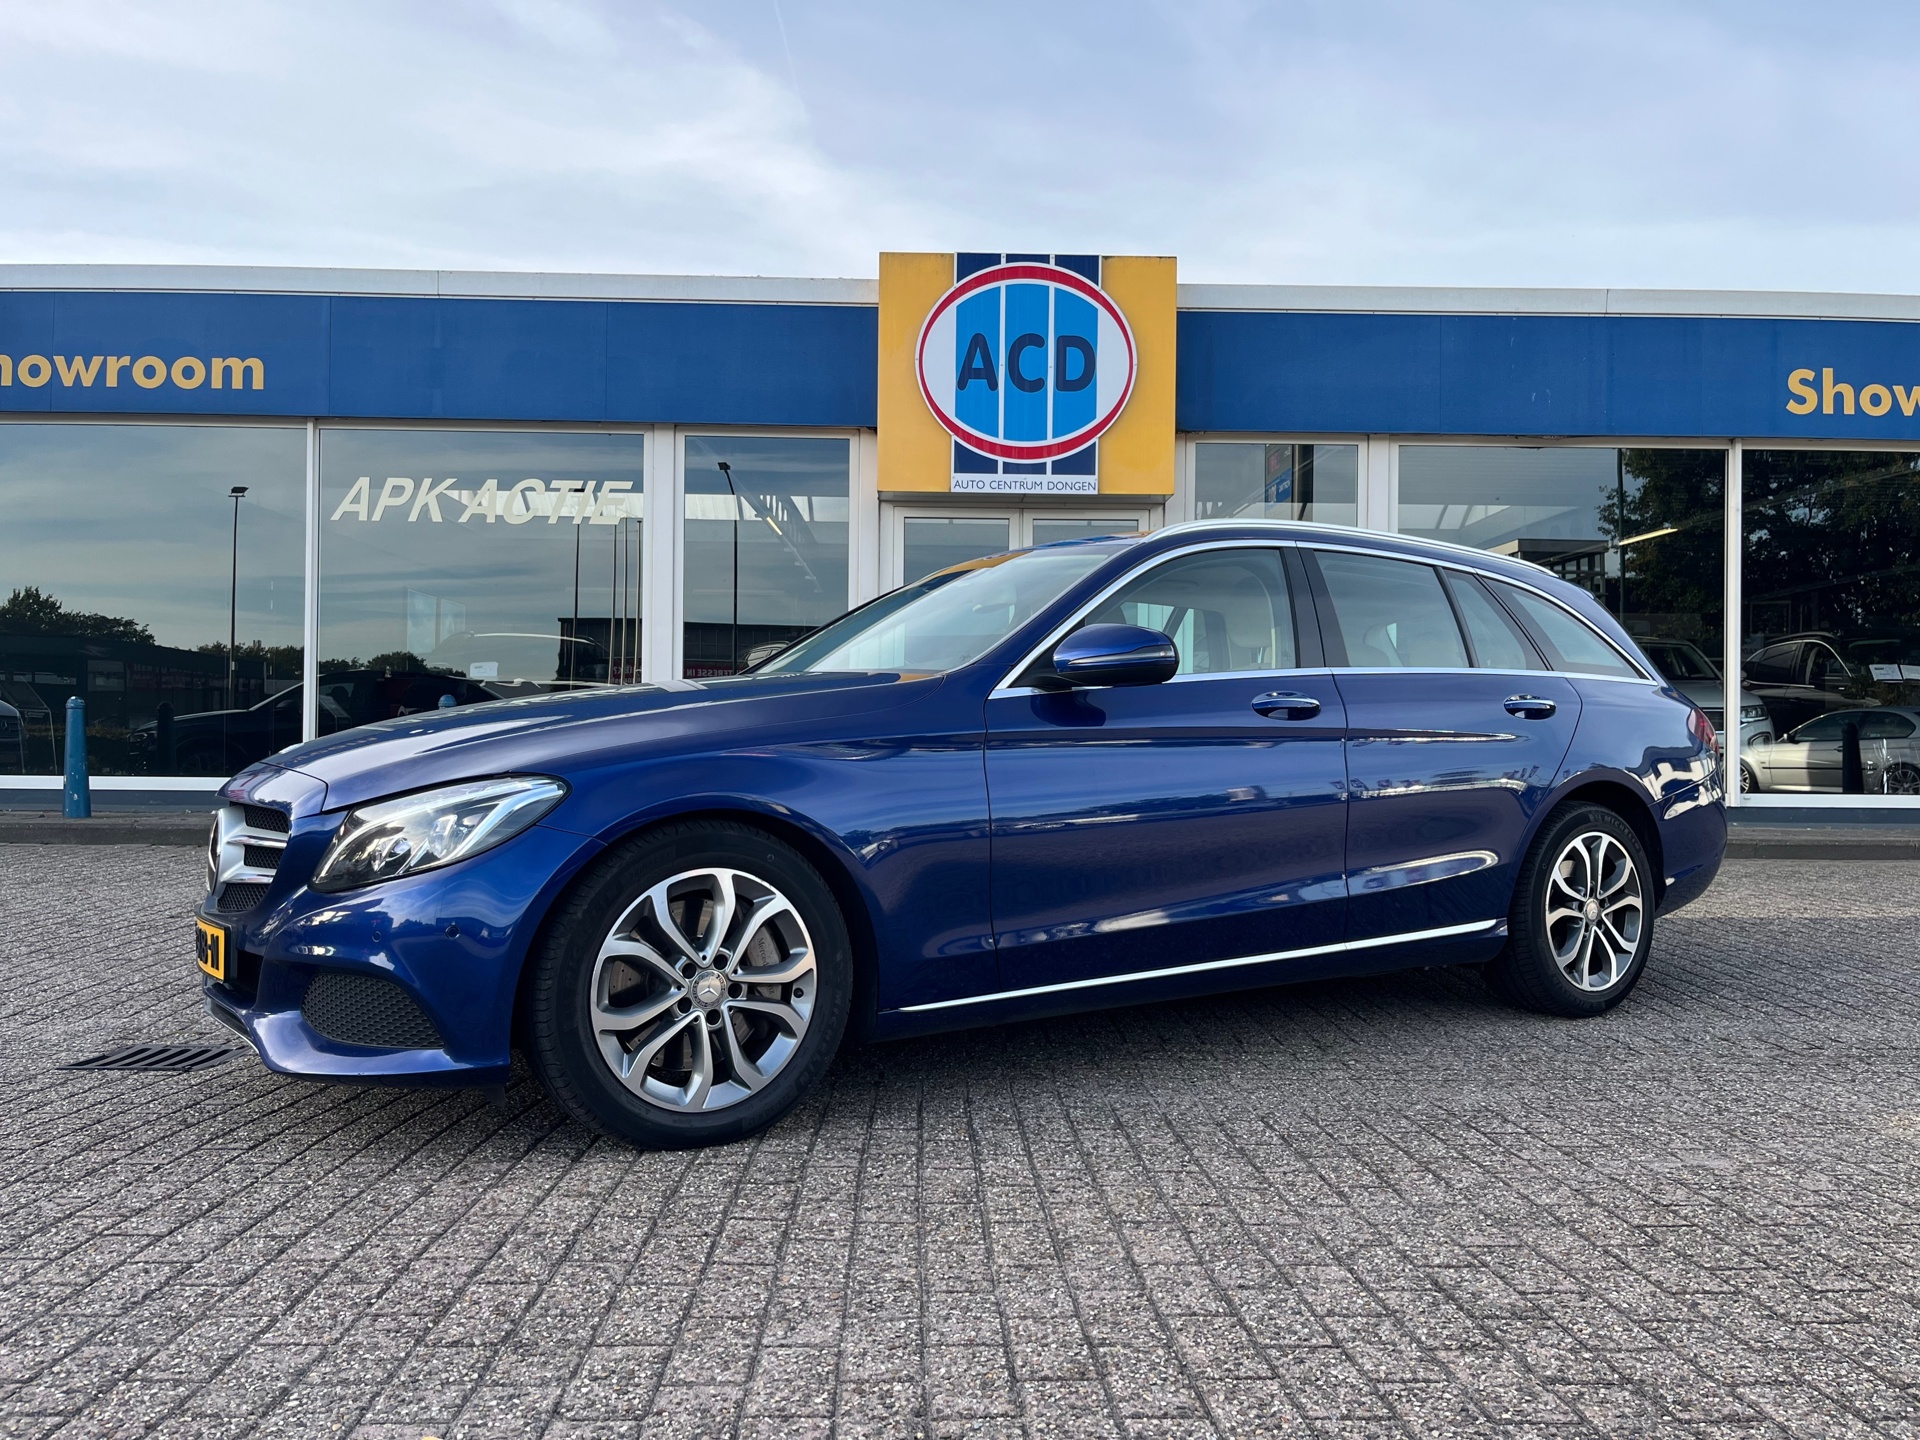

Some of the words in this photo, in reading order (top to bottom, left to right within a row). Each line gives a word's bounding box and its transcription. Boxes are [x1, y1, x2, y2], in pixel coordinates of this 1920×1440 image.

[957, 333, 1096, 393] ACD
[330, 477, 458, 522] APK
[457, 478, 634, 525] ACTIE
[953, 480, 986, 490] AUTO
[989, 481, 1043, 491] CENTRUM
[1047, 482, 1096, 491] DONGEN
